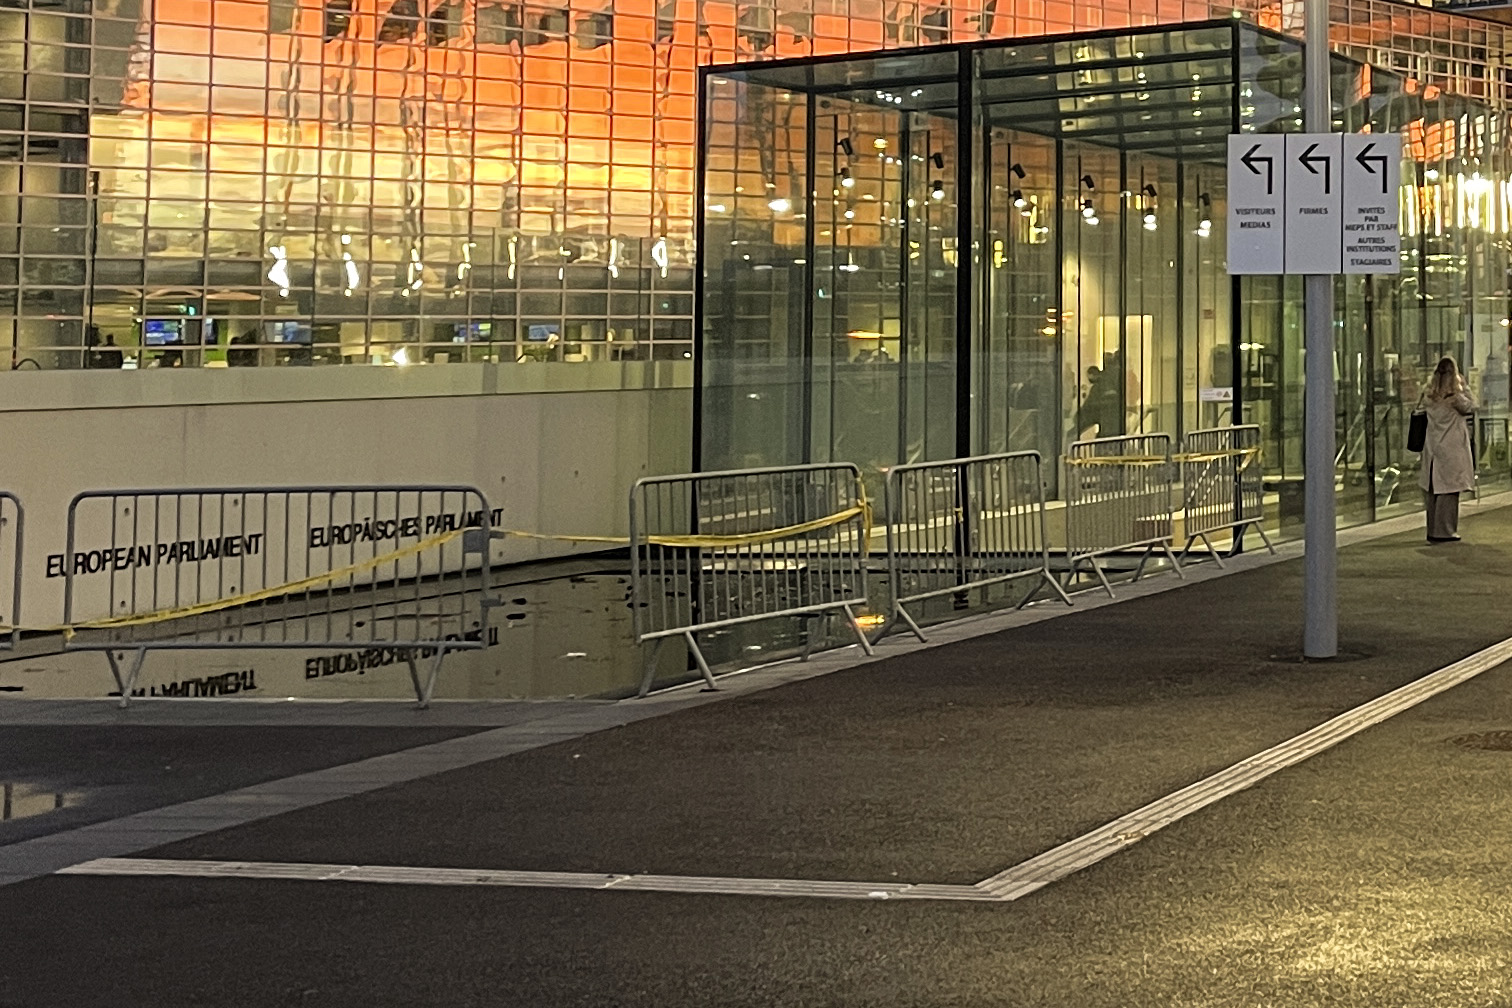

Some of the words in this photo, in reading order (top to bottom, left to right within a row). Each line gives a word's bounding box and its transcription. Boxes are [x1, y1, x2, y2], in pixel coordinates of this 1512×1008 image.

[1235, 207, 1276, 215] VISITEURS
[1299, 207, 1329, 215] FIRMES
[1364, 215, 1379, 223] PAR
[1346, 245, 1397, 253] INSTITUTIONS
[46, 544, 151, 578] EUROPEAN
[156, 533, 263, 565] PARLIAMENT
